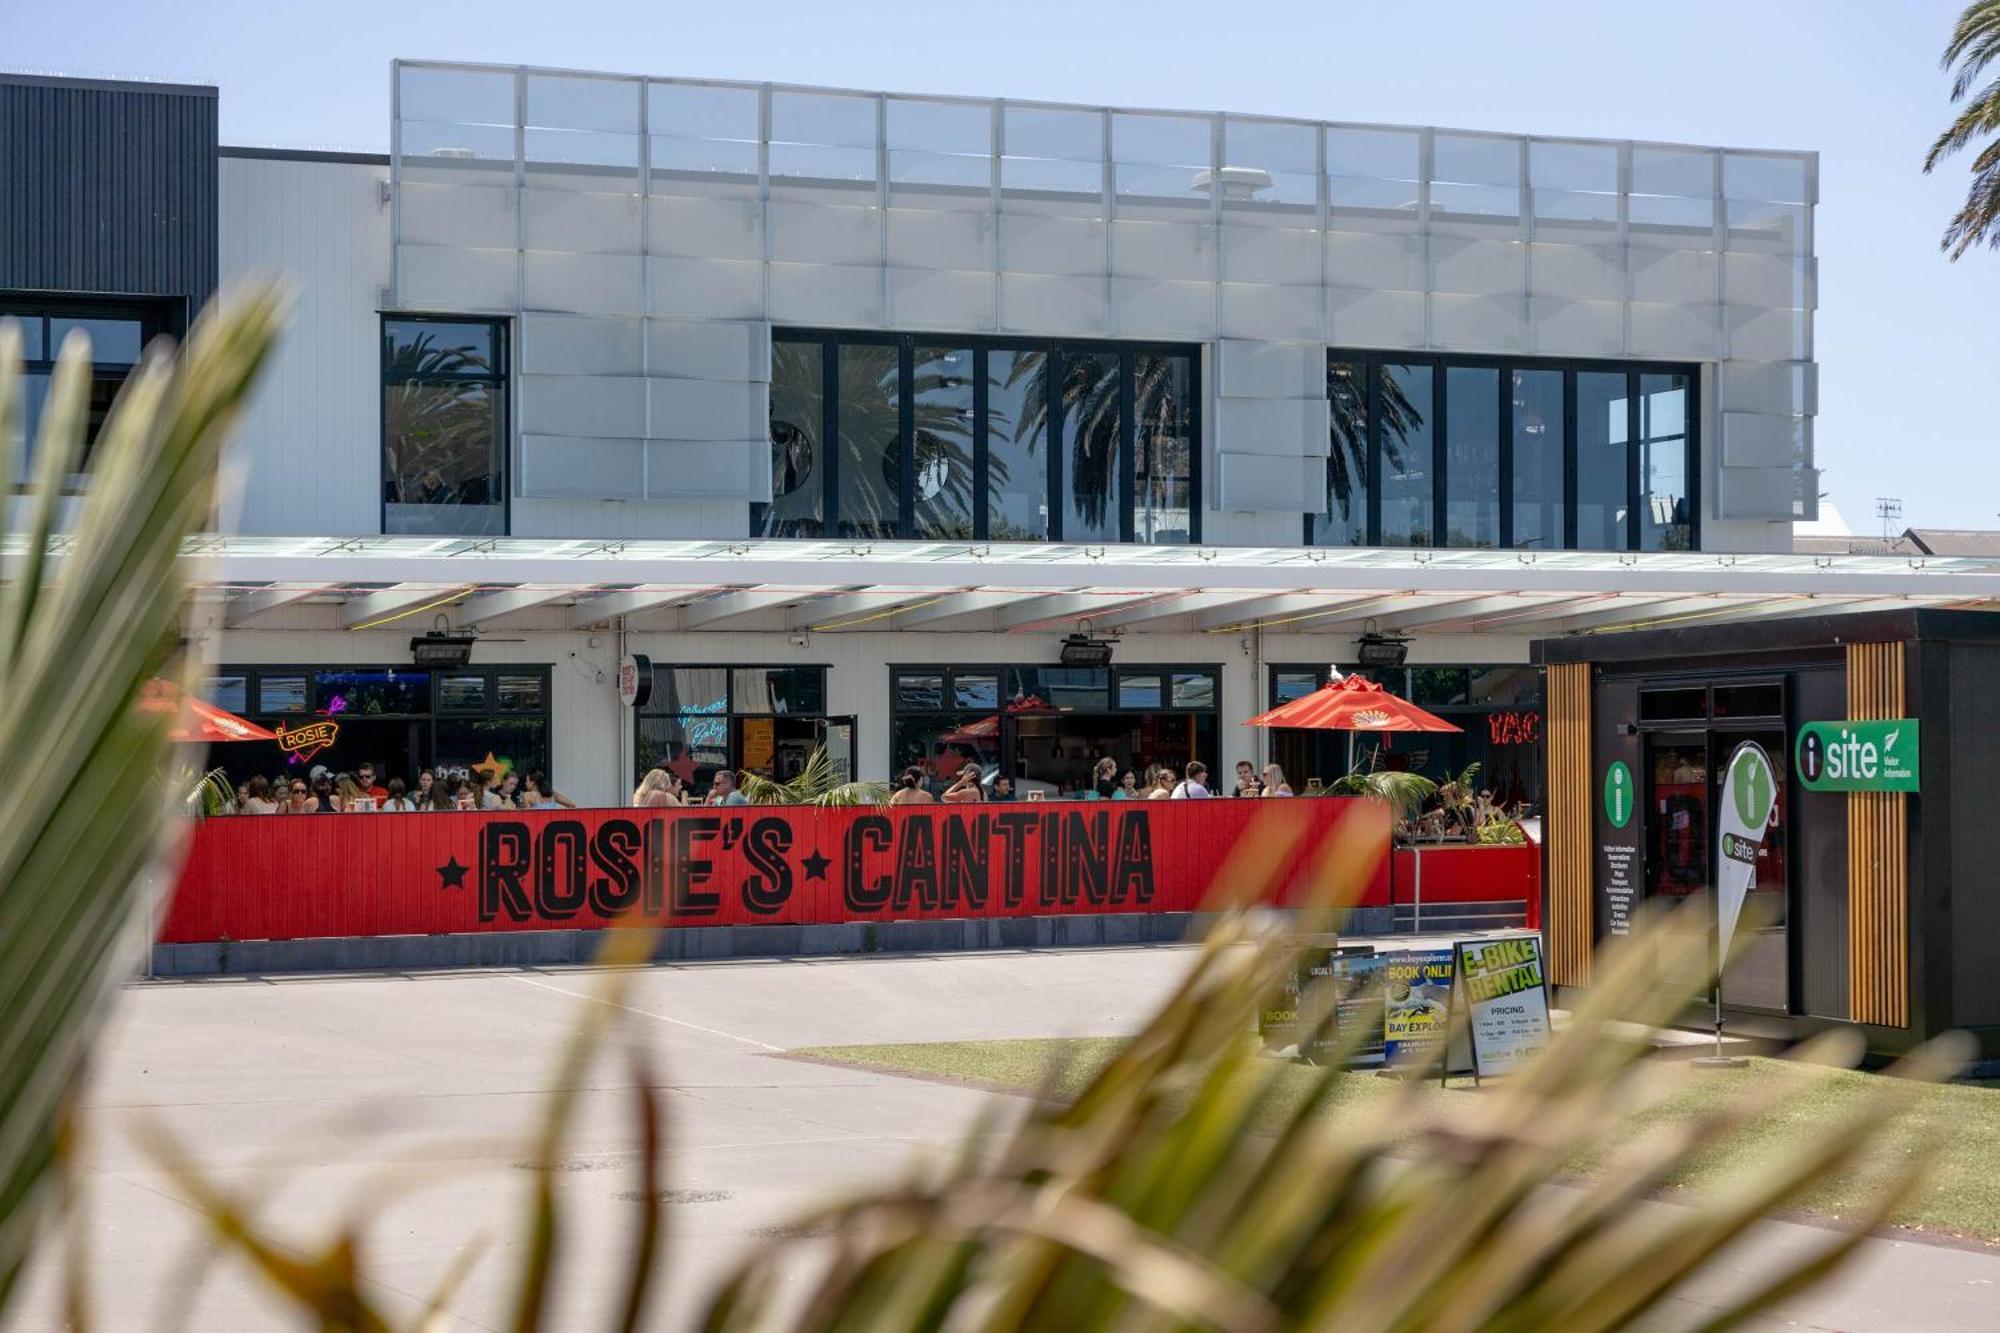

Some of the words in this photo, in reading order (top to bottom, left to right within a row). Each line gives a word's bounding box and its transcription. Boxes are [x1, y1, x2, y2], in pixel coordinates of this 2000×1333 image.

[286, 725, 329, 747] ROSIE
[1827, 729, 1878, 779] site
[1734, 838, 1754, 861] site
[478, 816, 793, 923] ROSIE'S
[843, 810, 1155, 913] CANTINA
[1463, 938, 1537, 977] E-BIKE
[1388, 965, 1420, 980] BOOK
[1466, 964, 1543, 1001] RENTAL
[1491, 1006, 1525, 1017] PRICING
[1389, 1022, 1408, 1034] BAY
